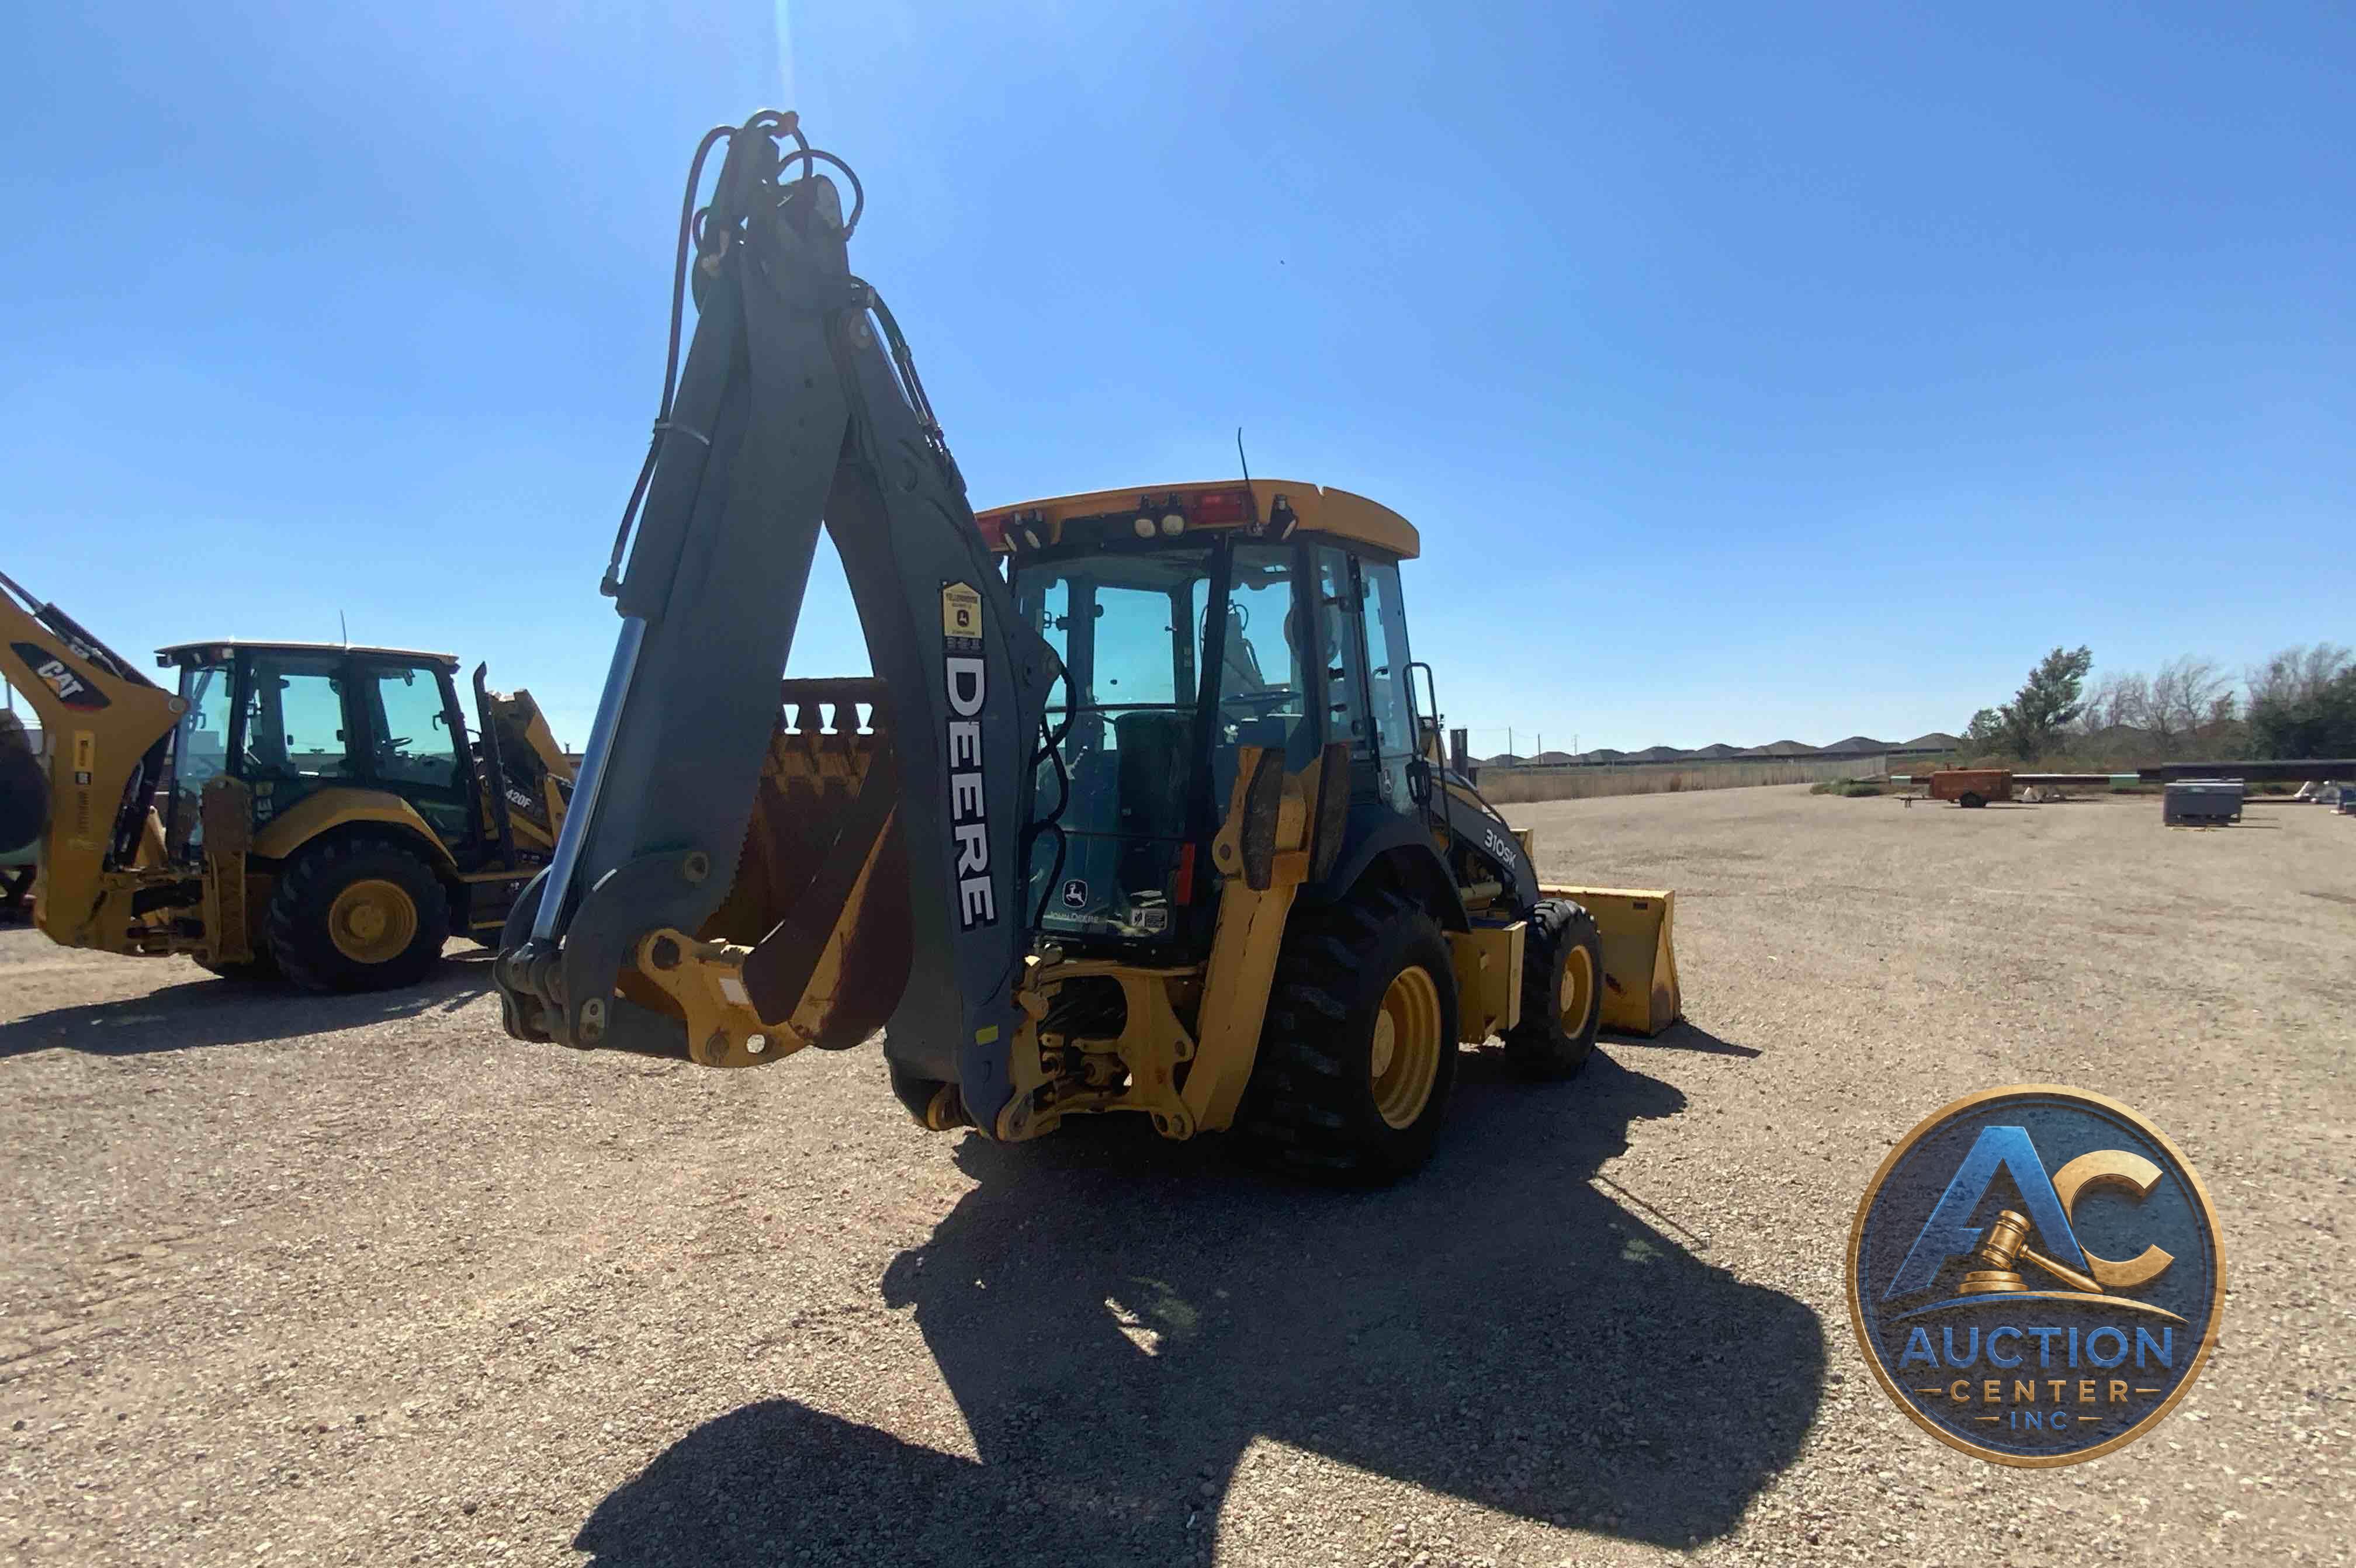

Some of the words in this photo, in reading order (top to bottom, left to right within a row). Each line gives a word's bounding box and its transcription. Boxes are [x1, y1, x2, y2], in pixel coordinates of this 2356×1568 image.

[37, 661, 84, 698] CAT
[505, 789, 532, 808] 420F
[946, 657, 995, 926] DEERE
[1484, 828, 1516, 870] 310SK
